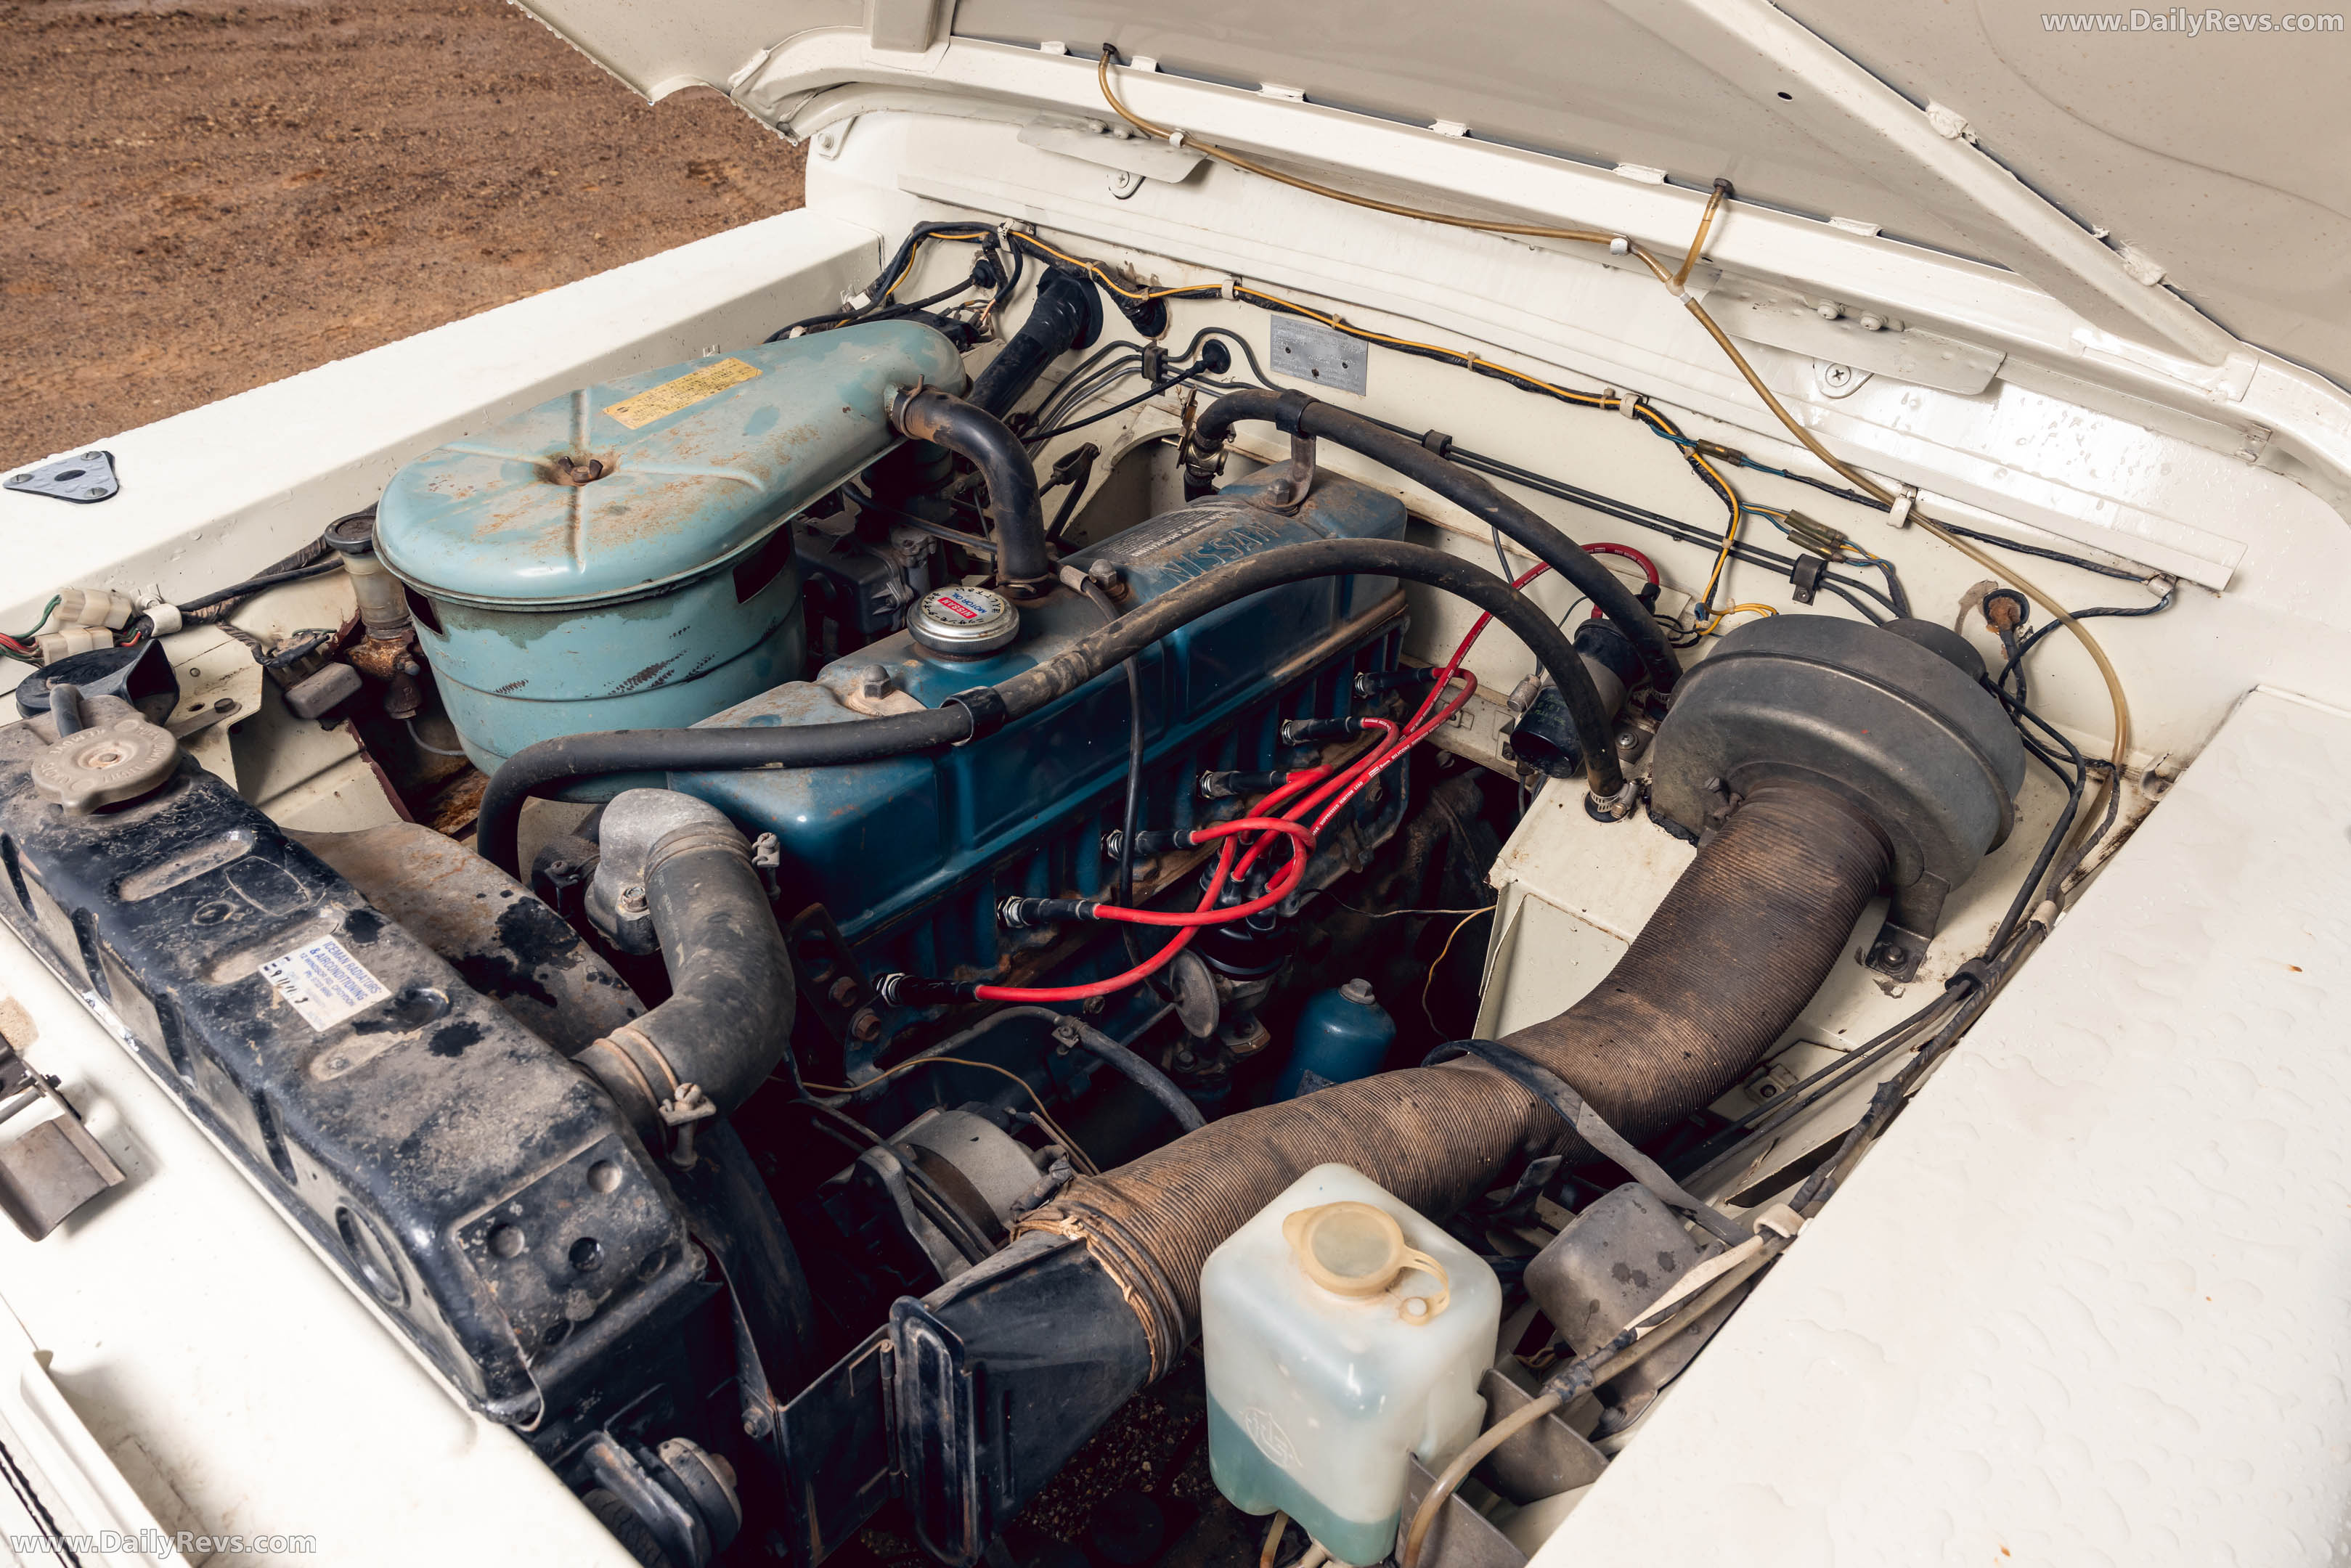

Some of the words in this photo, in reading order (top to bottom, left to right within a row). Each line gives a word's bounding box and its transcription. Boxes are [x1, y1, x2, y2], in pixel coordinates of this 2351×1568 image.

[1157, 520, 1282, 584] NISSAN
[942, 598, 972, 618] NISSAN
[952, 592, 963, 601] OIL
[962, 598, 987, 613] MOTOR
[1390, 744, 1410, 760] SILICONE
[1320, 804, 1340, 825] SUPPRESSED
[1339, 789, 1354, 804] IGNITION
[1353, 781, 1364, 791] LEAD
[314, 953, 368, 1000] AIRCONDITIONING
[322, 941, 350, 965] ICEMAN
[344, 963, 381, 994] RADIATORS
